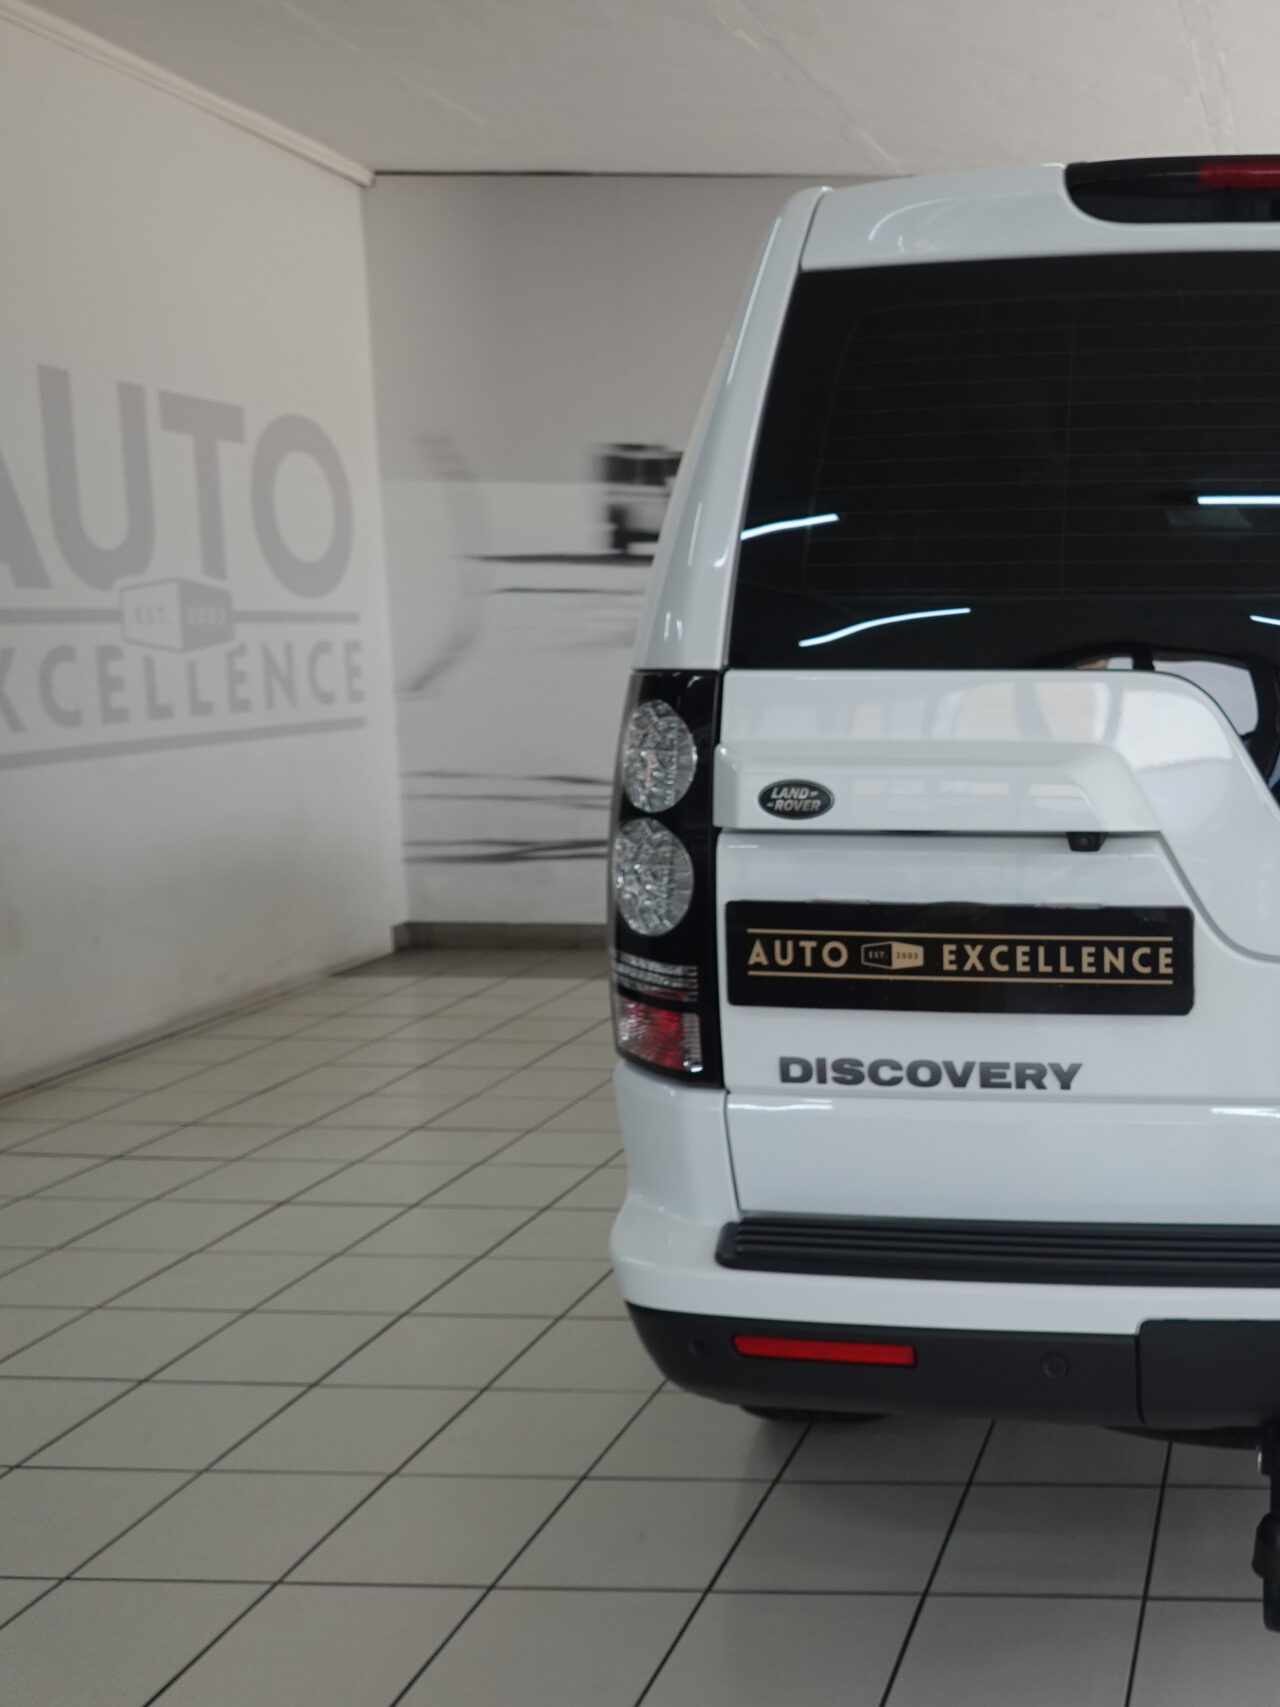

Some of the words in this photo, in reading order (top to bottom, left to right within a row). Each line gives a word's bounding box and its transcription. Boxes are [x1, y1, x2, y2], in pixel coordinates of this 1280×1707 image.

[770, 786, 810, 799] LAND
[774, 799, 822, 812] ROVER
[747, 939, 849, 969] AUTO
[942, 943, 1174, 976] EXCELLENCE
[779, 1056, 1083, 1091] DISCOVERY
